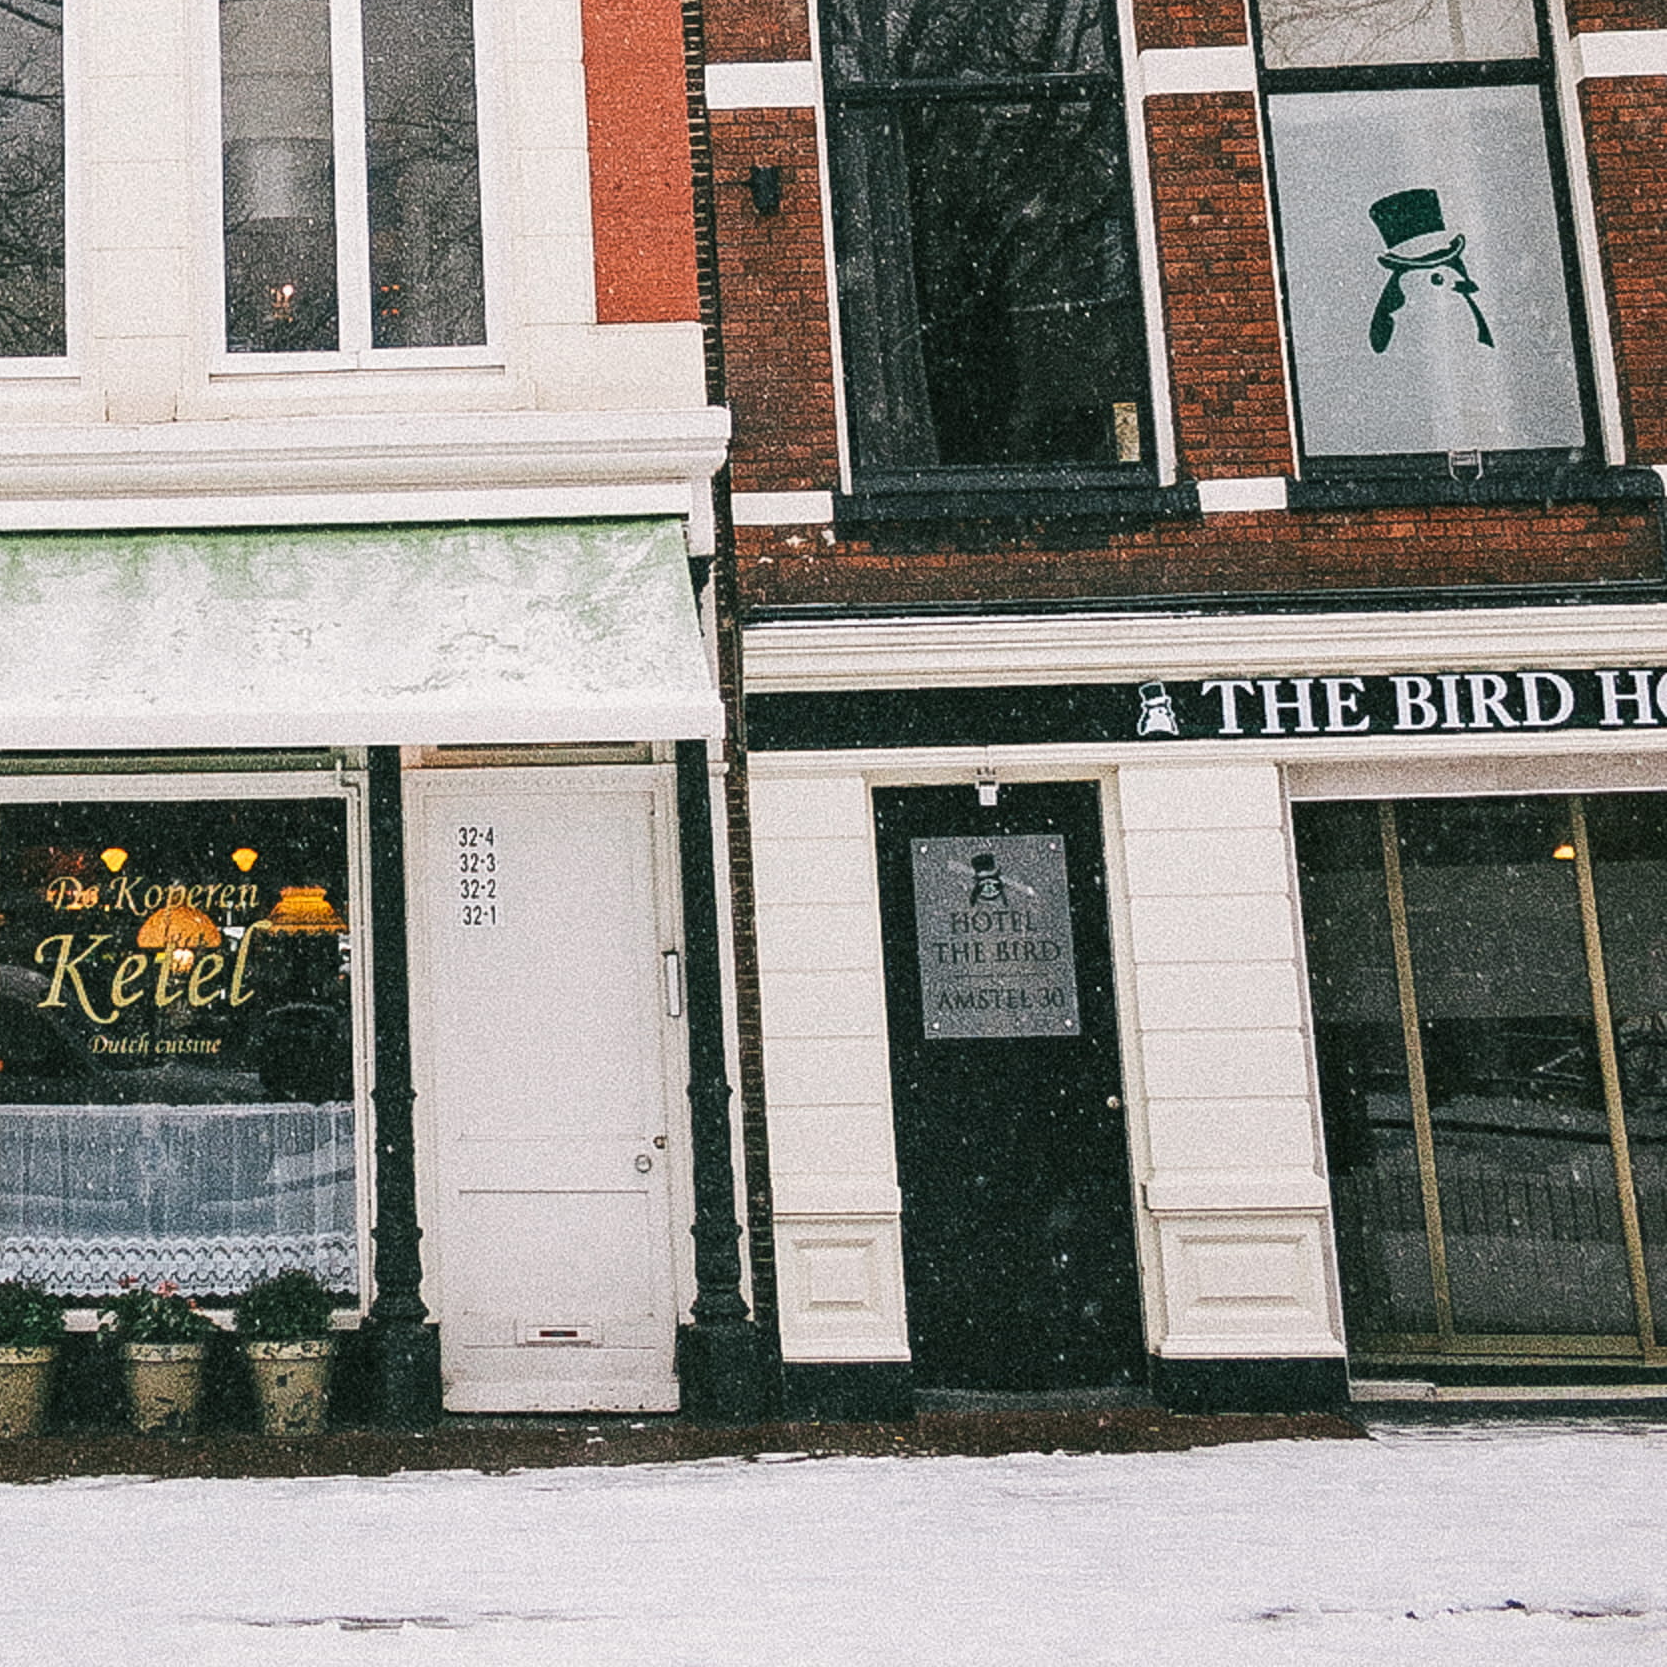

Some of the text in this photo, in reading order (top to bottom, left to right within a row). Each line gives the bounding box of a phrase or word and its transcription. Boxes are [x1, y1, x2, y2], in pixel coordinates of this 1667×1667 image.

[1201, 669, 1667, 735] THE BIRD H
[45, 875, 259, 929] De Koperen
[950, 910, 1037, 934] HOTEL
[933, 940, 1061, 964] THE BIRD
[34, 920, 274, 1025] Ketel
[938, 986, 1067, 1011] AMSTEL 30
[91, 1032, 222, 1055] Dutch cuisine
